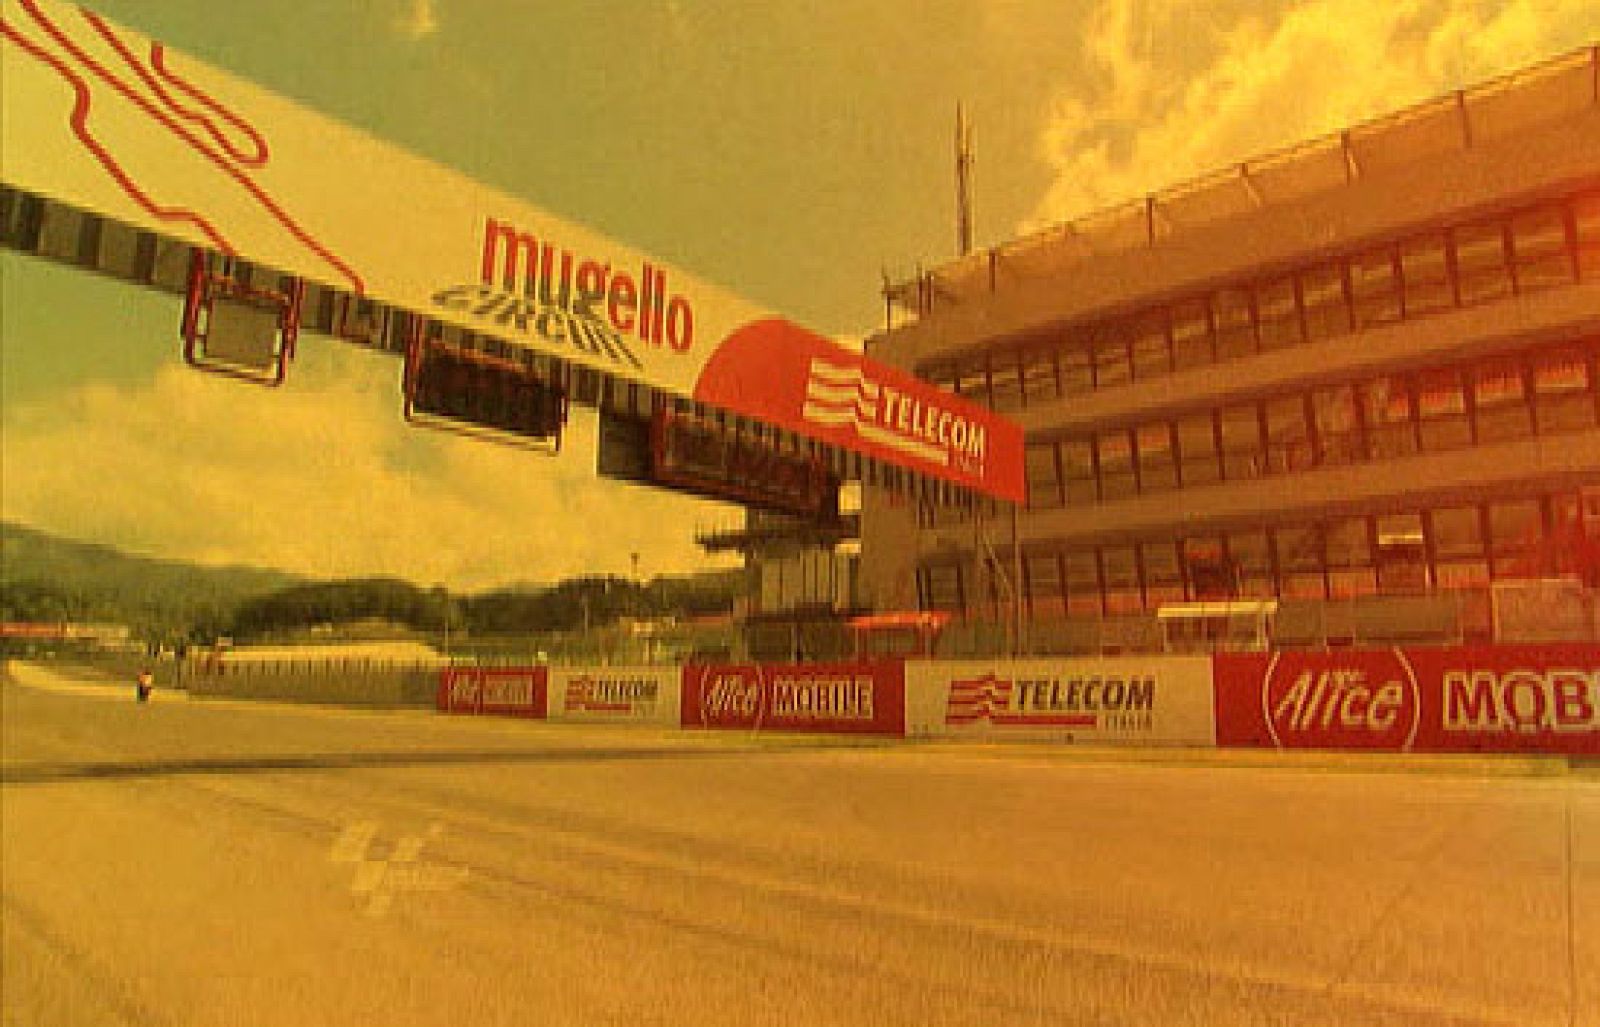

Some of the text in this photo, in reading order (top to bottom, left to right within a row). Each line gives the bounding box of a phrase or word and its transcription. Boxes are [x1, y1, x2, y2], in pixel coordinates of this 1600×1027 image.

[481, 217, 694, 350] mugello
[881, 386, 987, 462] TELECOM
[772, 674, 874, 720] MOBILE
[1015, 676, 1155, 711] TELECOM
